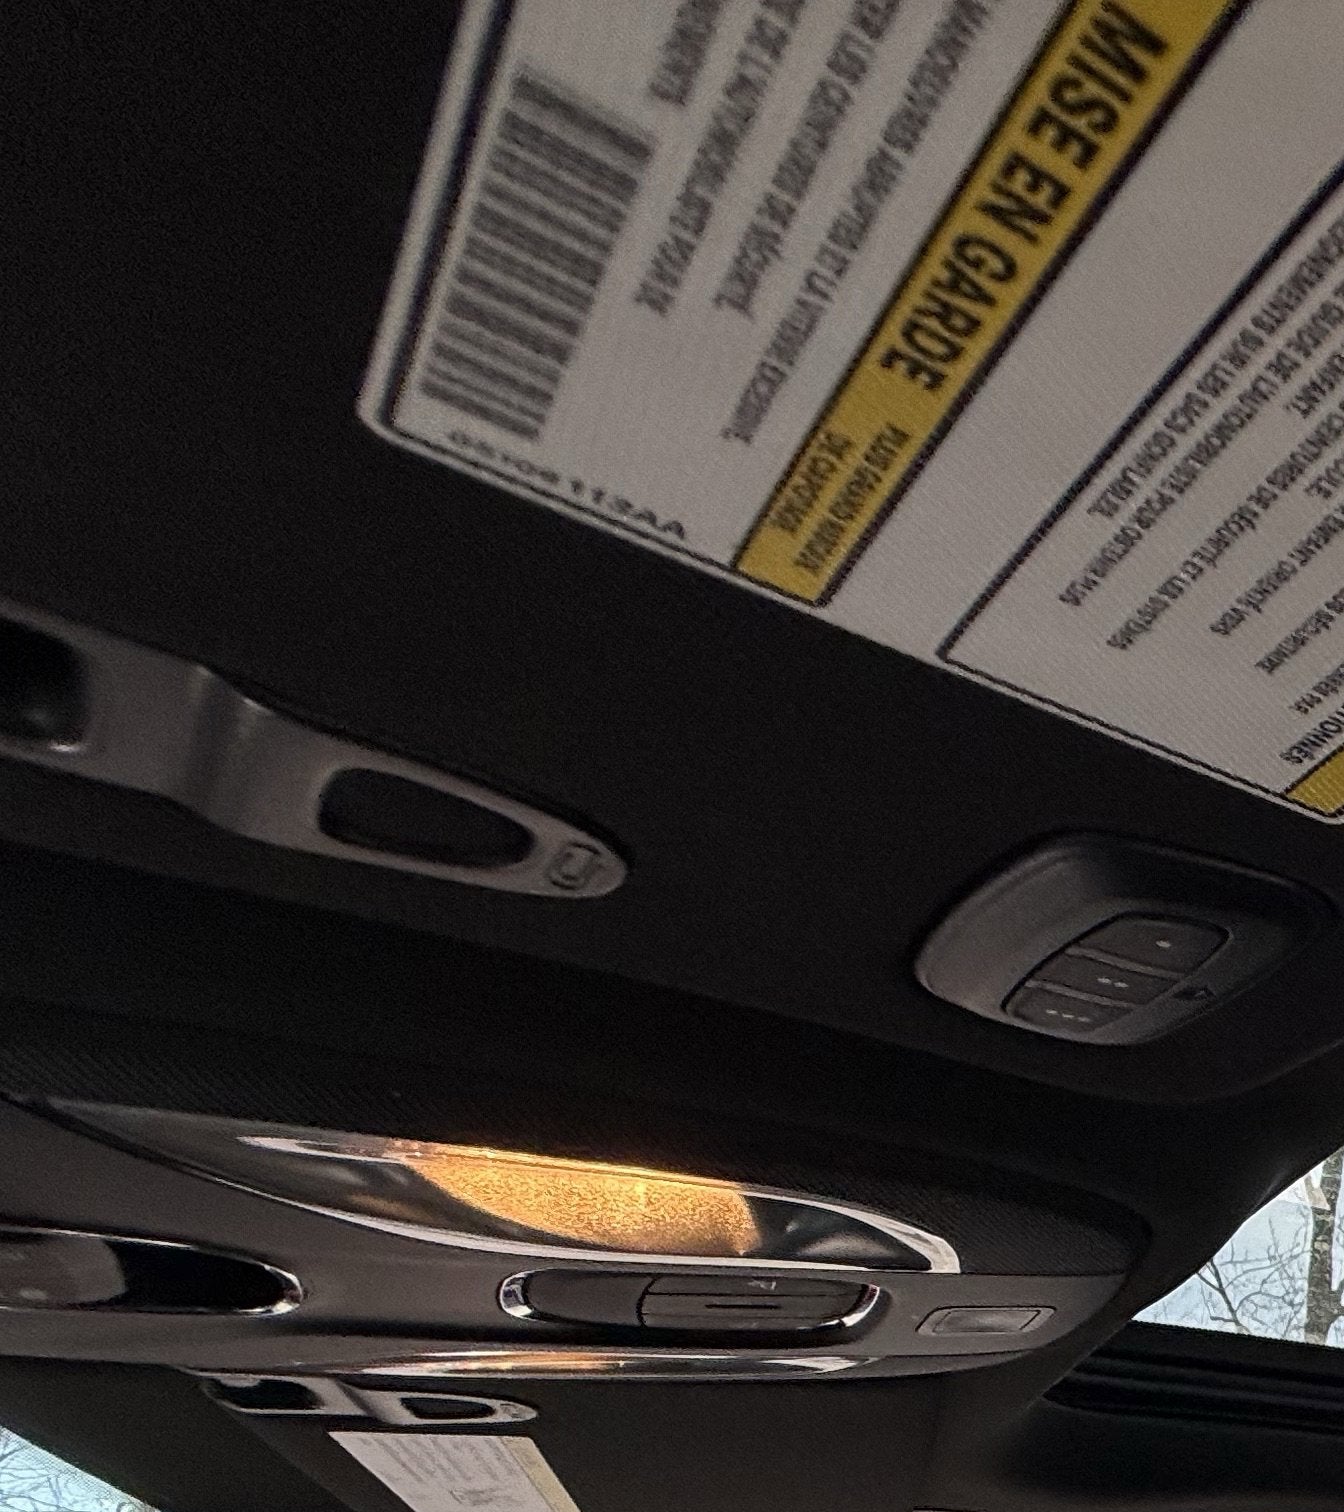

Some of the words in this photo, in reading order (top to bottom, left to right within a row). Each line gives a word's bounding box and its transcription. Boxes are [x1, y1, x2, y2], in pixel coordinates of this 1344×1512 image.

[741, 12, 791, 67] DE
[823, 25, 879, 89] LES
[1022, 0, 1172, 175] MISE
[753, 189, 799, 233] DE
[974, 147, 1075, 249] EN
[643, 226, 699, 292] POUR
[811, 241, 854, 279] ET
[632, 279, 676, 319] DE
[799, 267, 841, 304] LA
[877, 225, 1025, 398] GARDE
[1215, 324, 1269, 374] SUR
[1261, 348, 1304, 384] DE
[1191, 361, 1238, 401] LES
[1125, 487, 1179, 532] POUR
[1244, 484, 1282, 512] DE
